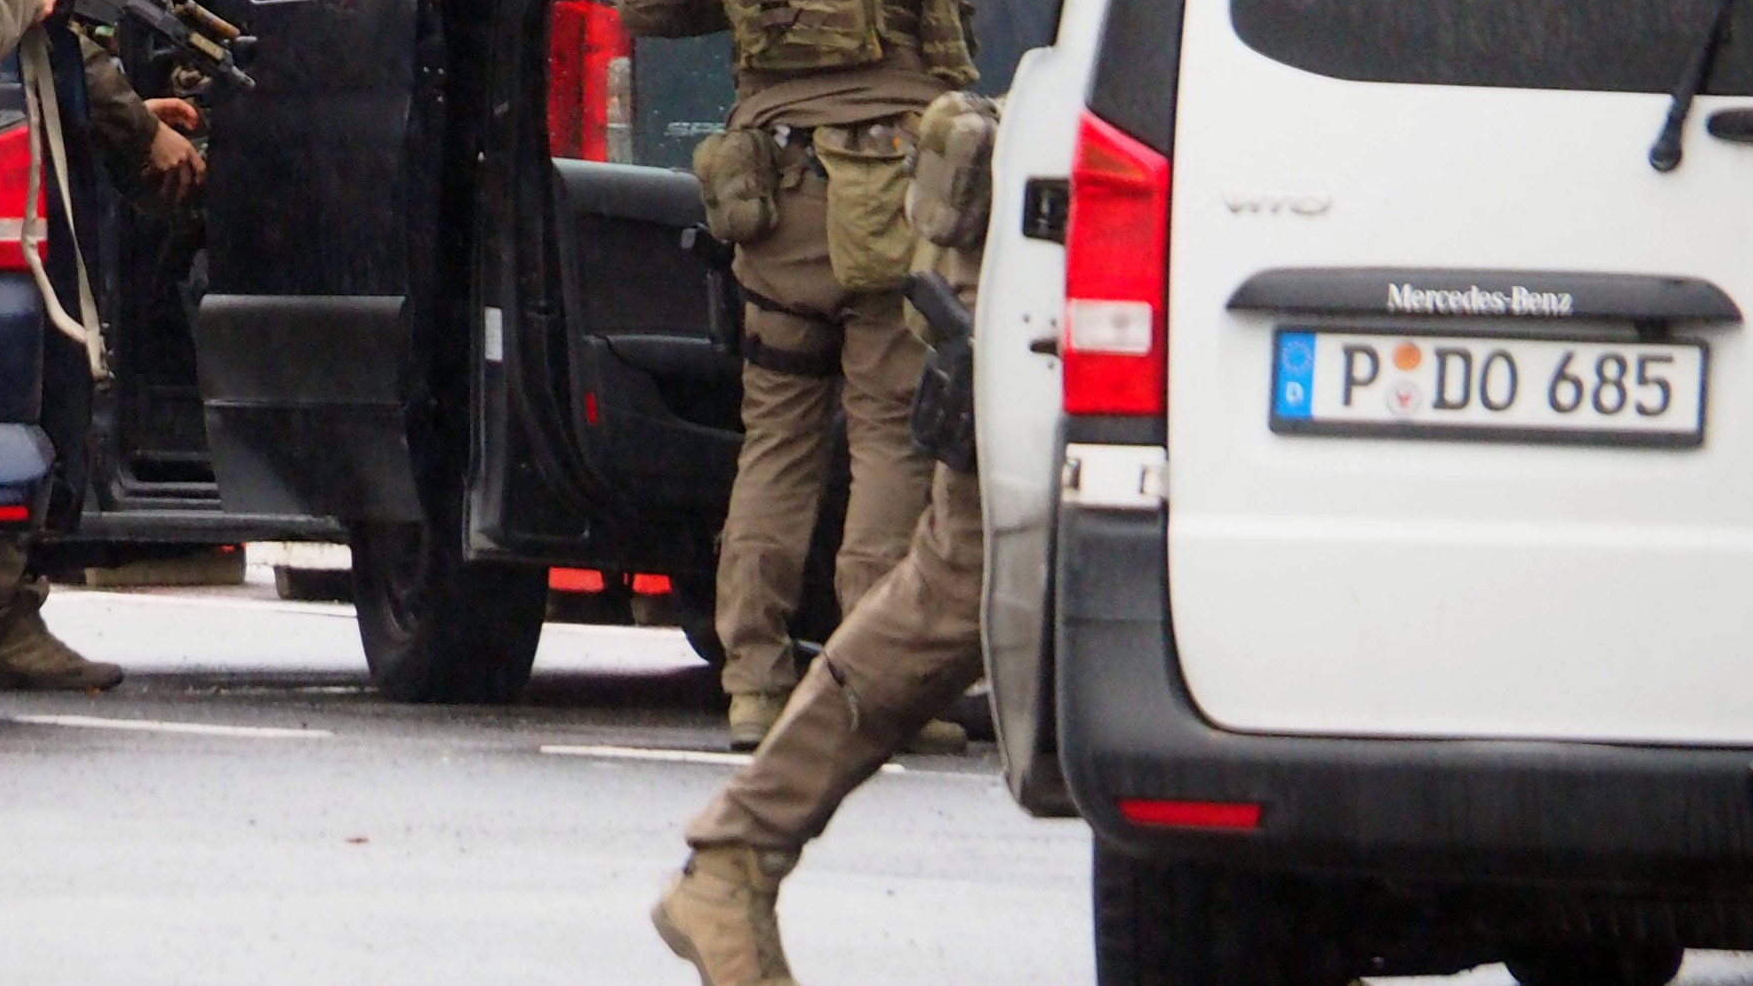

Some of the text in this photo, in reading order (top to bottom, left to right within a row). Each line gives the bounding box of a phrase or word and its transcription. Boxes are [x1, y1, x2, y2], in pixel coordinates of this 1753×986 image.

[1386, 283, 1575, 316] Mercedes-Benz
[1341, 344, 1676, 417] P DO 685
